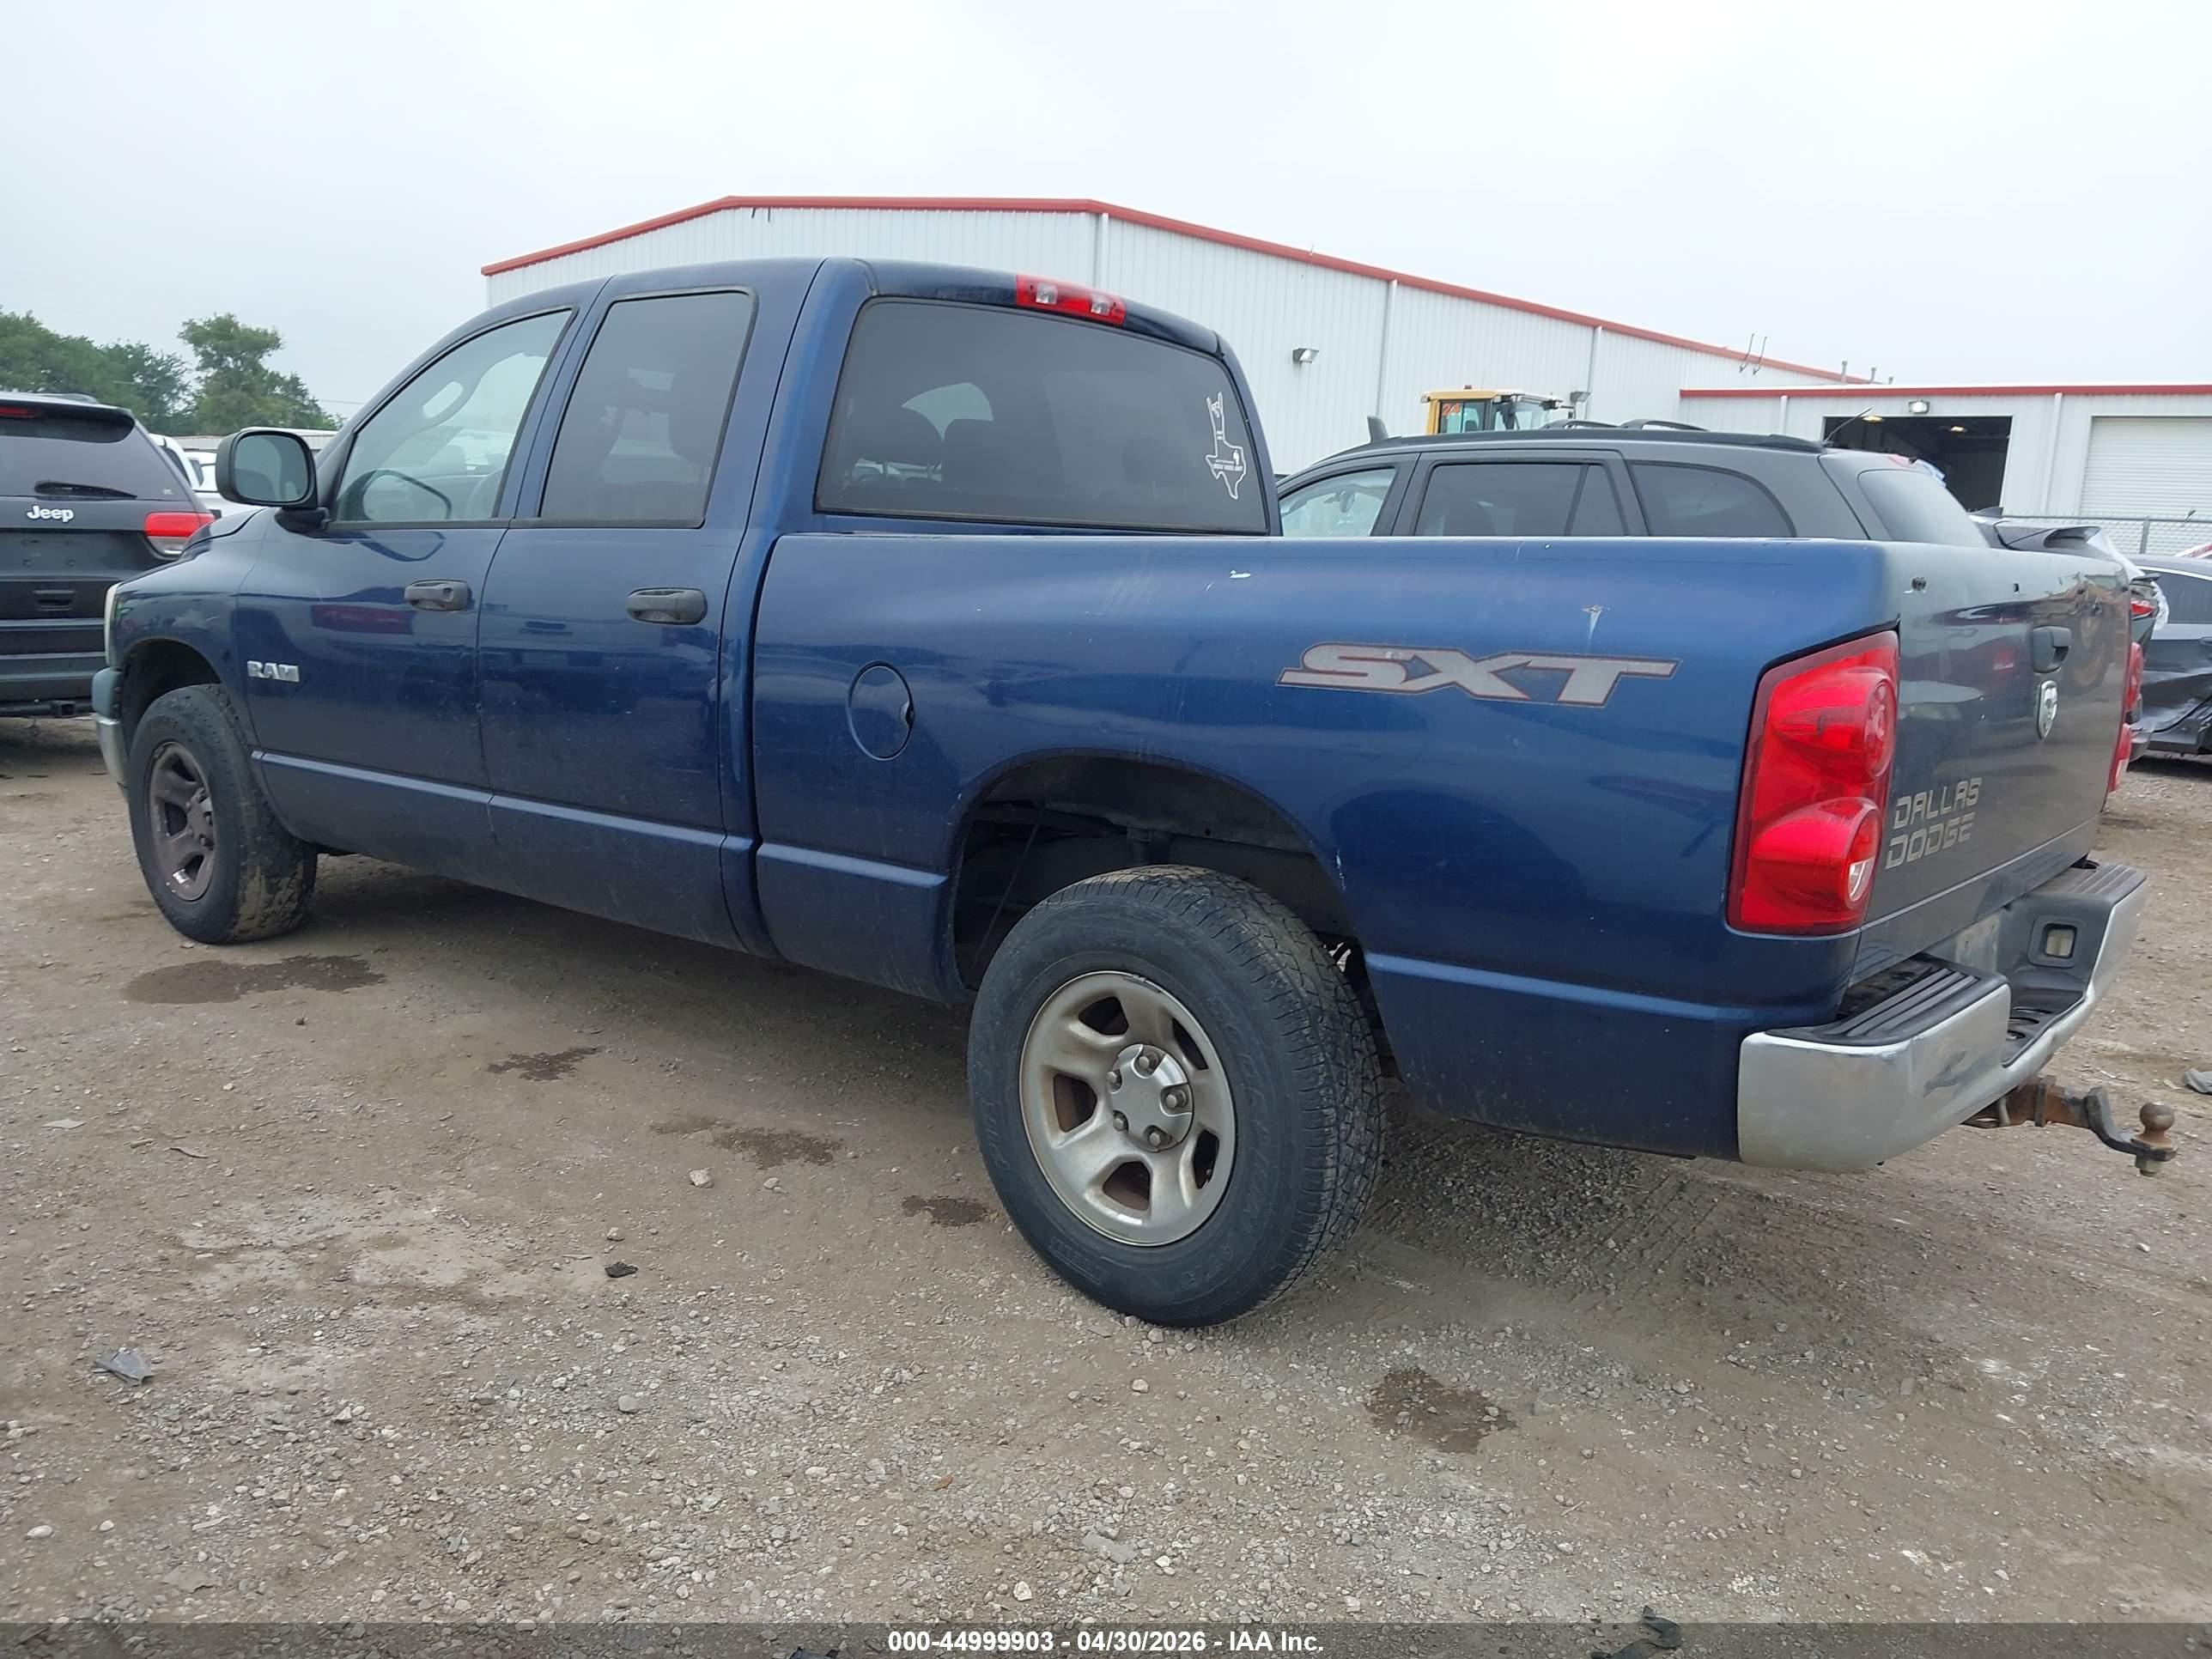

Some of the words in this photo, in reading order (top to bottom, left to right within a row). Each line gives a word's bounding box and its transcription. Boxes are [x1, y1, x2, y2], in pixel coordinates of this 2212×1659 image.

[27, 505, 75, 523] Jeep
[246, 659, 301, 683] RAM
[1274, 642, 1683, 708] SXT
[1893, 777, 1983, 830] DALLAS
[1885, 811, 1976, 870] DODGE
